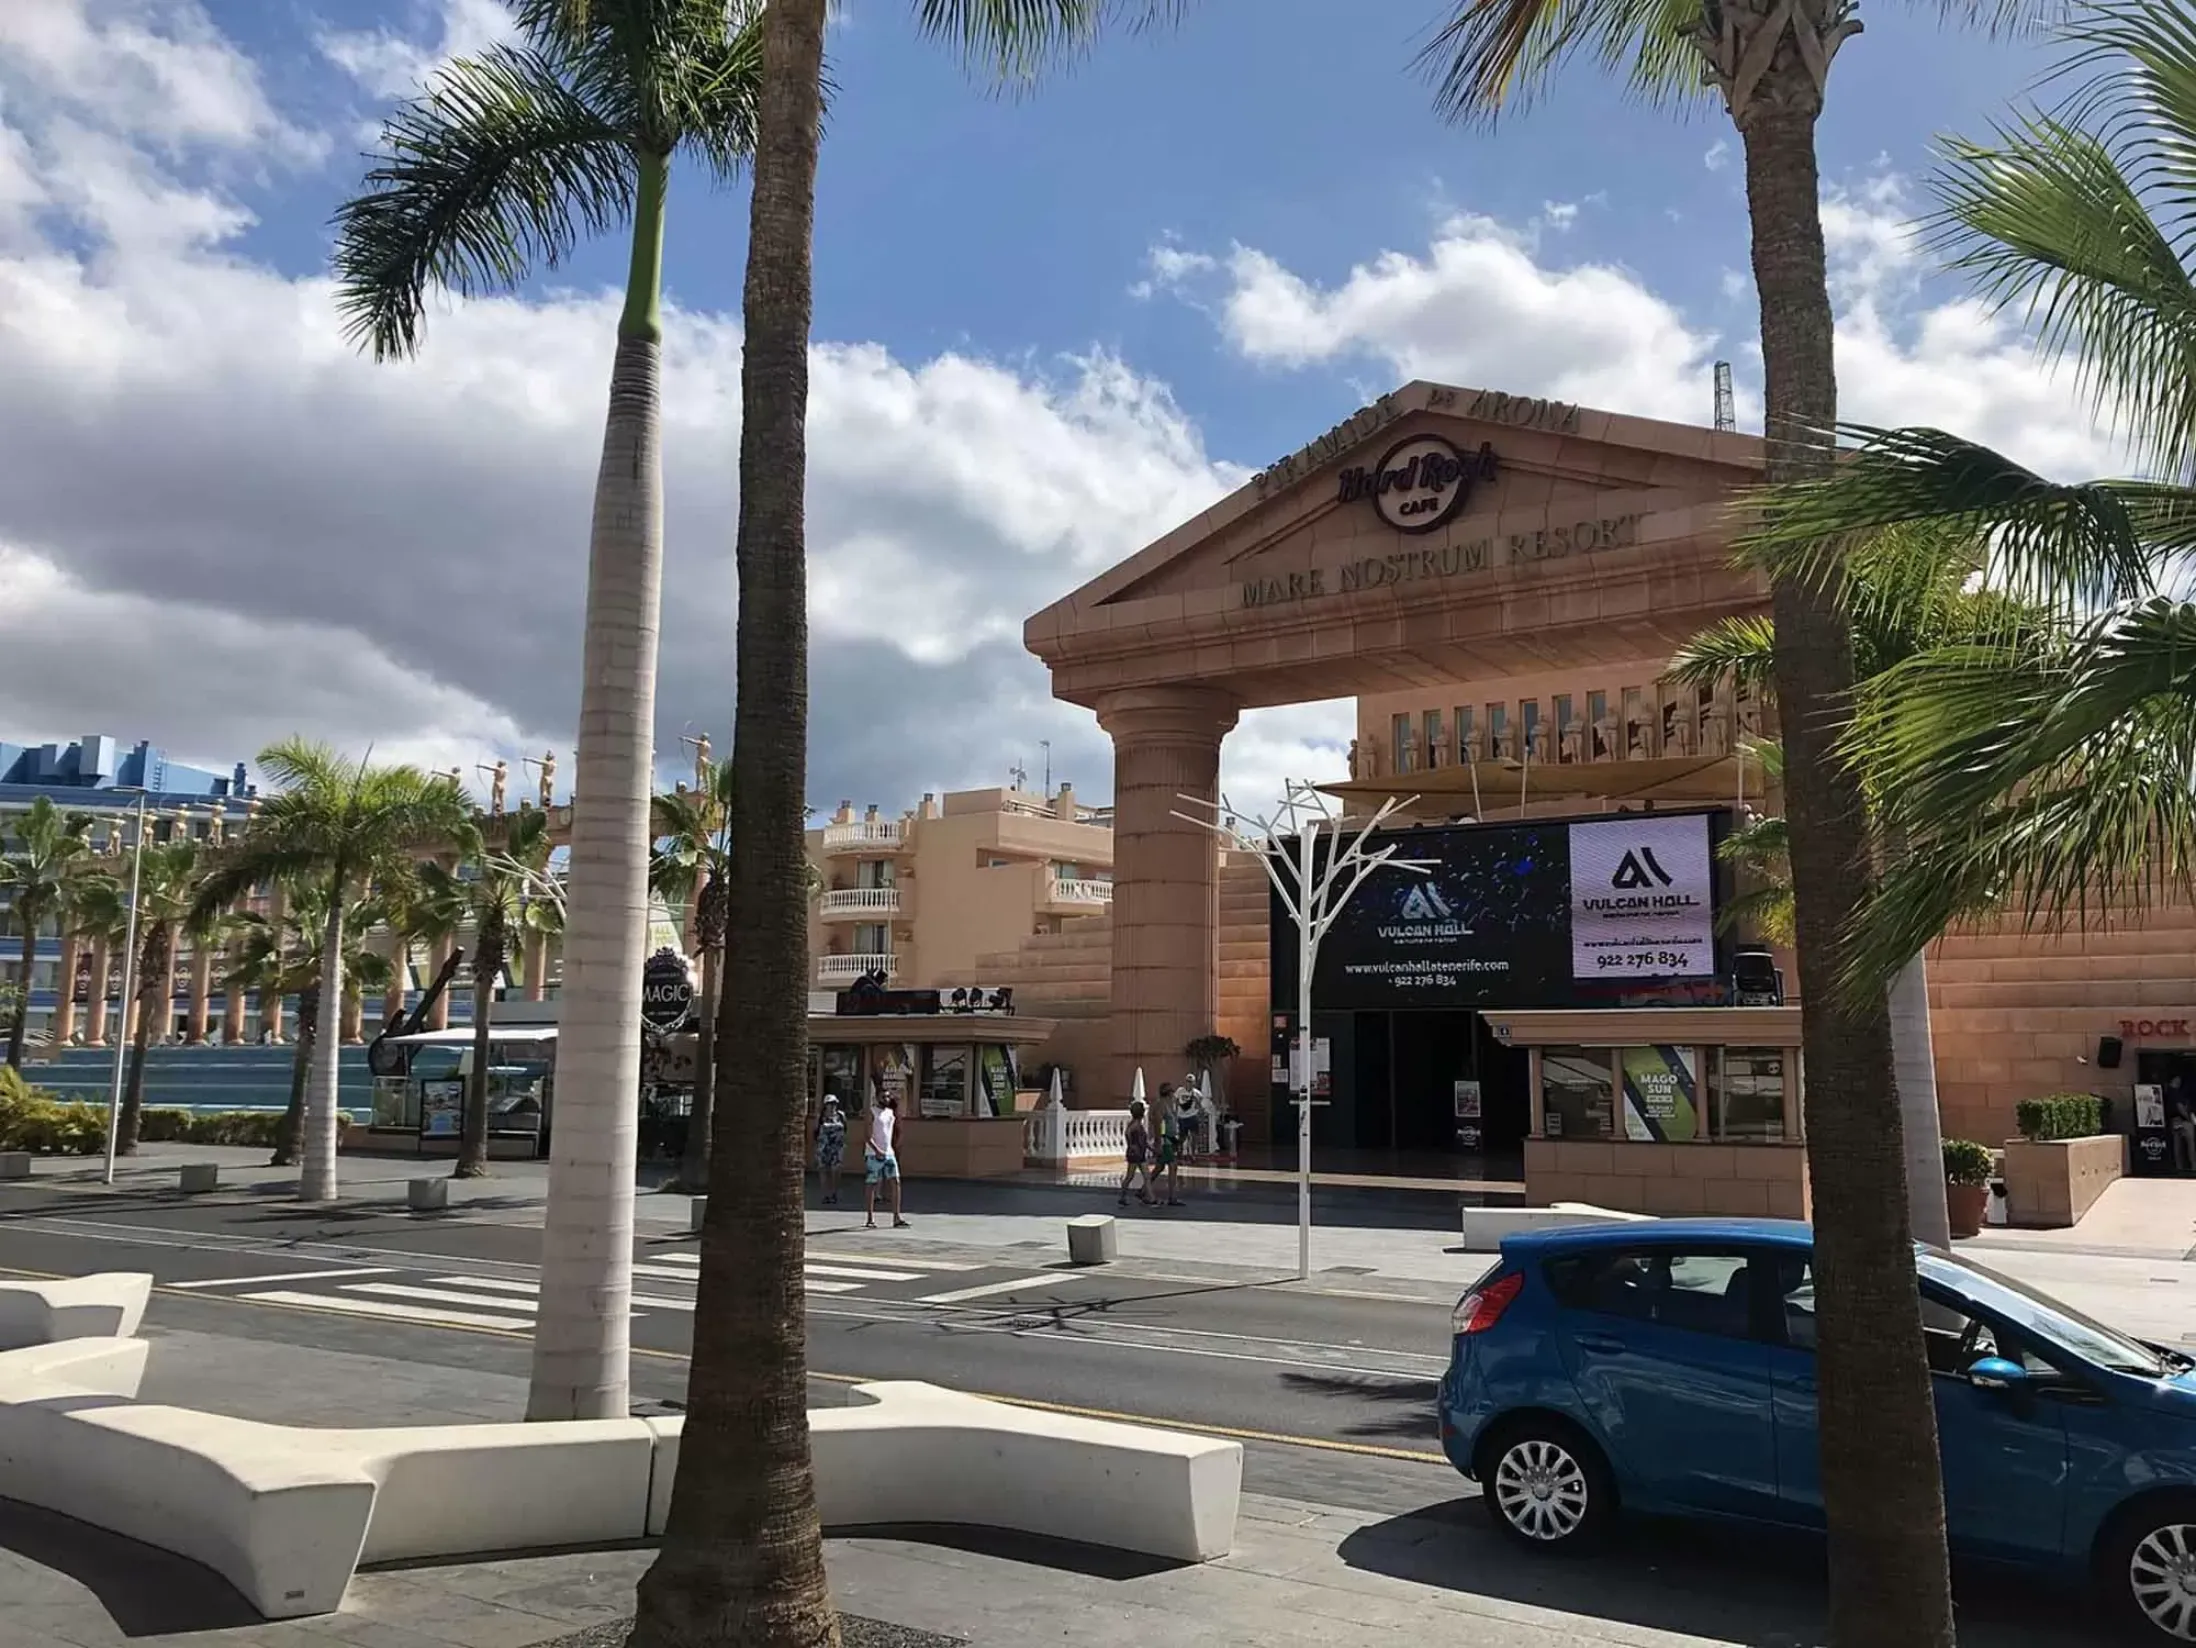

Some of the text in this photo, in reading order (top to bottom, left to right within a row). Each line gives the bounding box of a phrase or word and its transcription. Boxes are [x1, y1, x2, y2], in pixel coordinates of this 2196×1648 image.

[1467, 388, 1581, 434] ARONA
[1339, 441, 1497, 502] Hard Rock
[1399, 497, 1439, 515] CAFE
[1241, 512, 1643, 608] MARE NOSTRUM RESORT
[1582, 894, 1701, 911] VULCAN HALL
[1376, 921, 1475, 938] VULCAN HALL
[1597, 951, 1689, 969] 922 276 834
[1394, 974, 1457, 988] 922 276 834
[2118, 1019, 2192, 1037] ROCK
[1647, 1084, 1672, 1094] SUN
